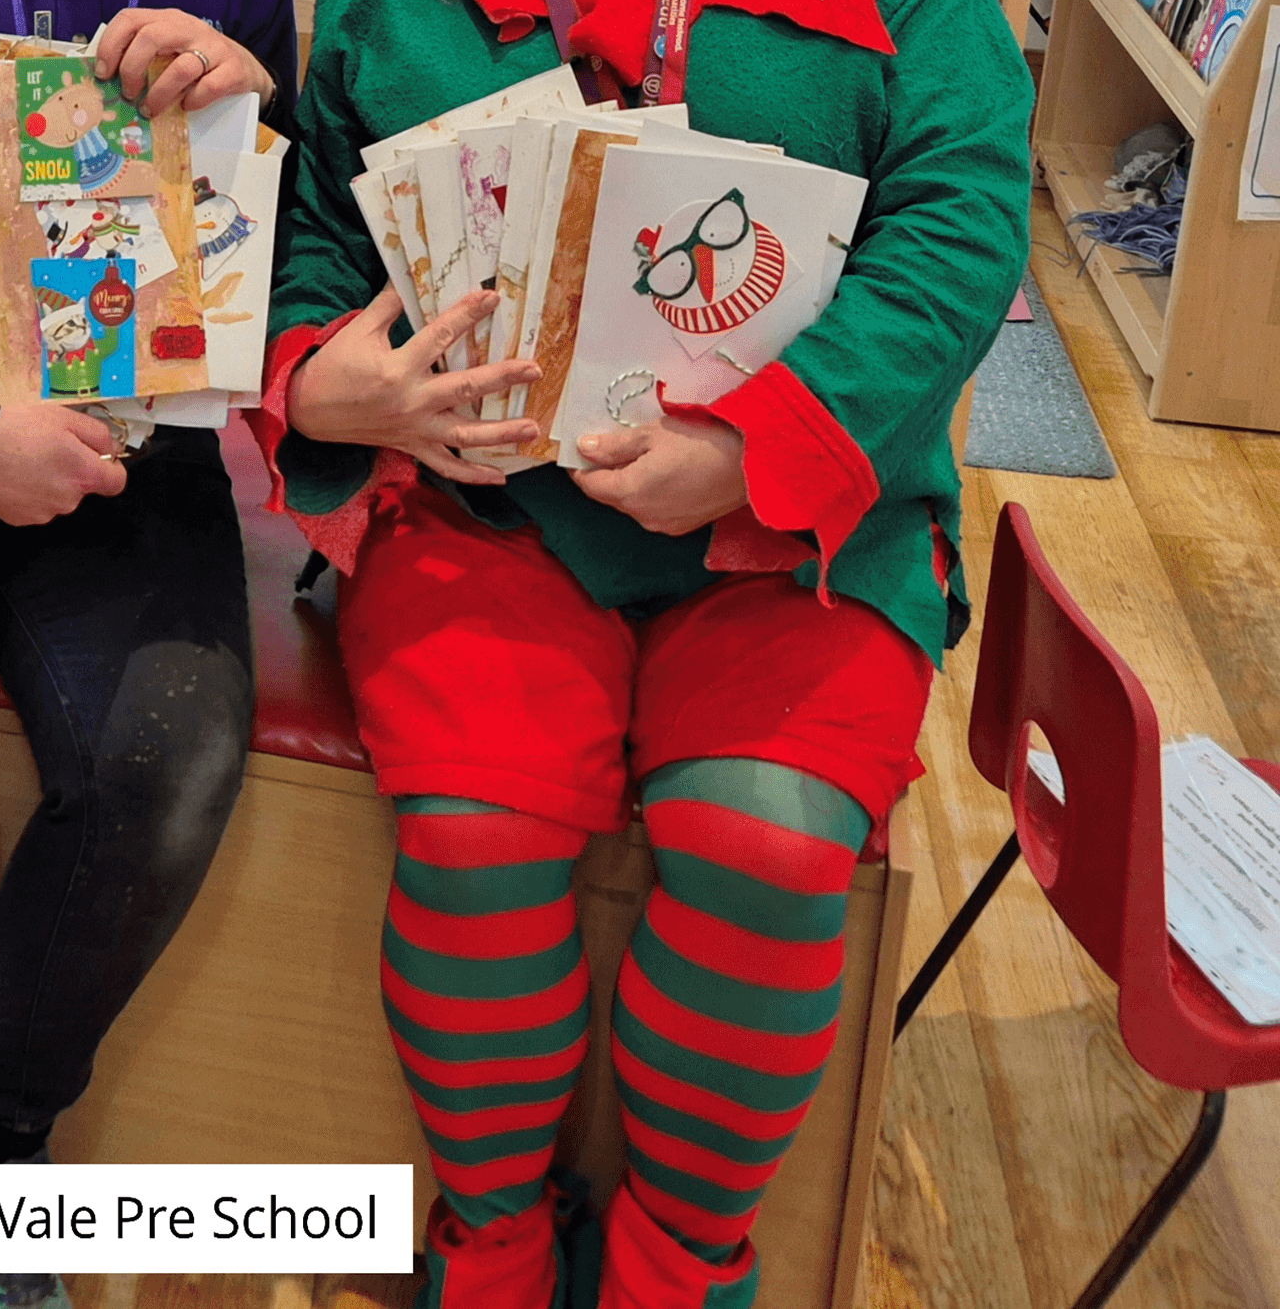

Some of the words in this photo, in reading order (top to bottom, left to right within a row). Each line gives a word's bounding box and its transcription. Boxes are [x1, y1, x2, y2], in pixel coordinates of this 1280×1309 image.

[26, 70, 43, 85] LET
[32, 88, 42, 101] IT
[24, 159, 72, 181] SNOW
